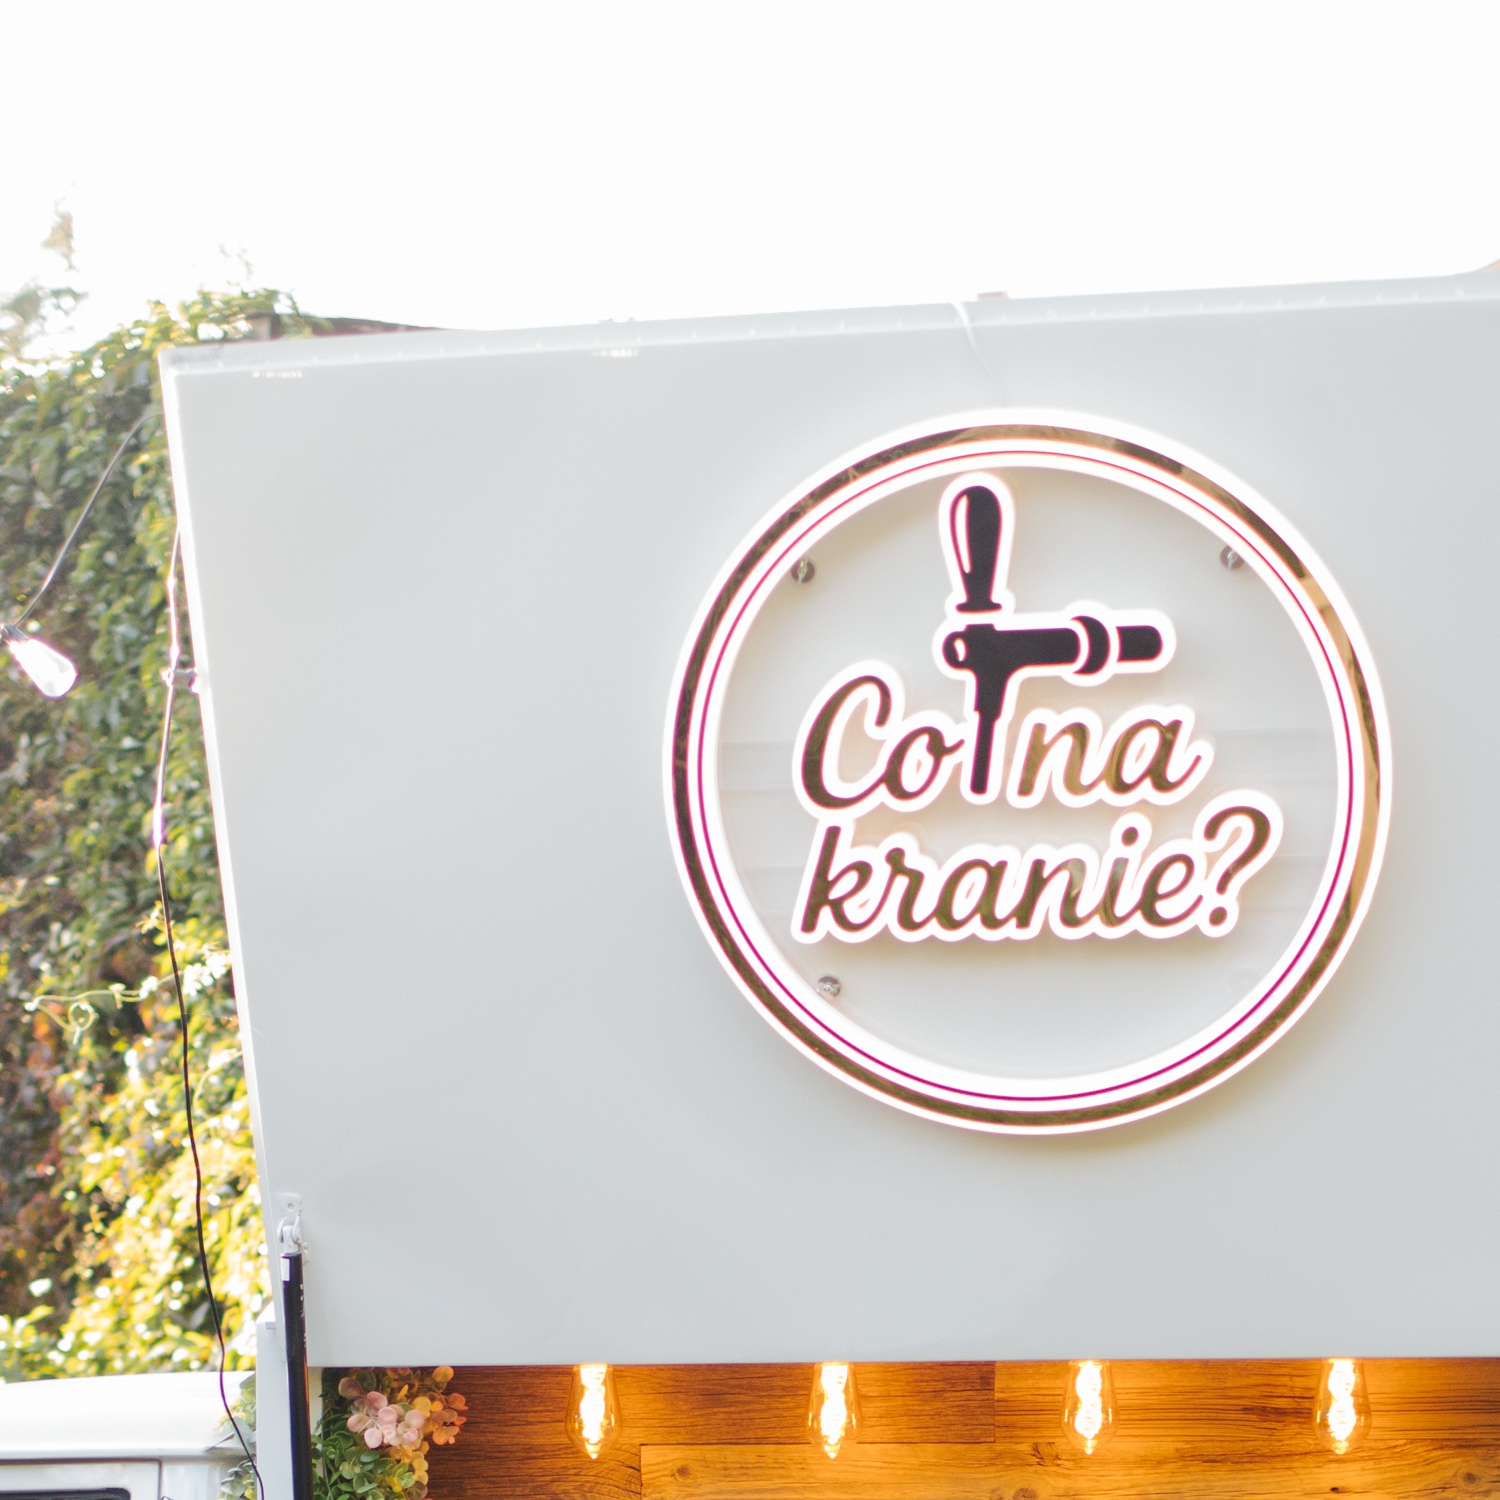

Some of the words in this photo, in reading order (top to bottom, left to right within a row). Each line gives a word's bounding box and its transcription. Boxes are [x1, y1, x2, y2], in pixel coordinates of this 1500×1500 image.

[801, 674, 965, 811] Co
[1016, 717, 1203, 798] na
[799, 805, 1272, 935] kranie?
